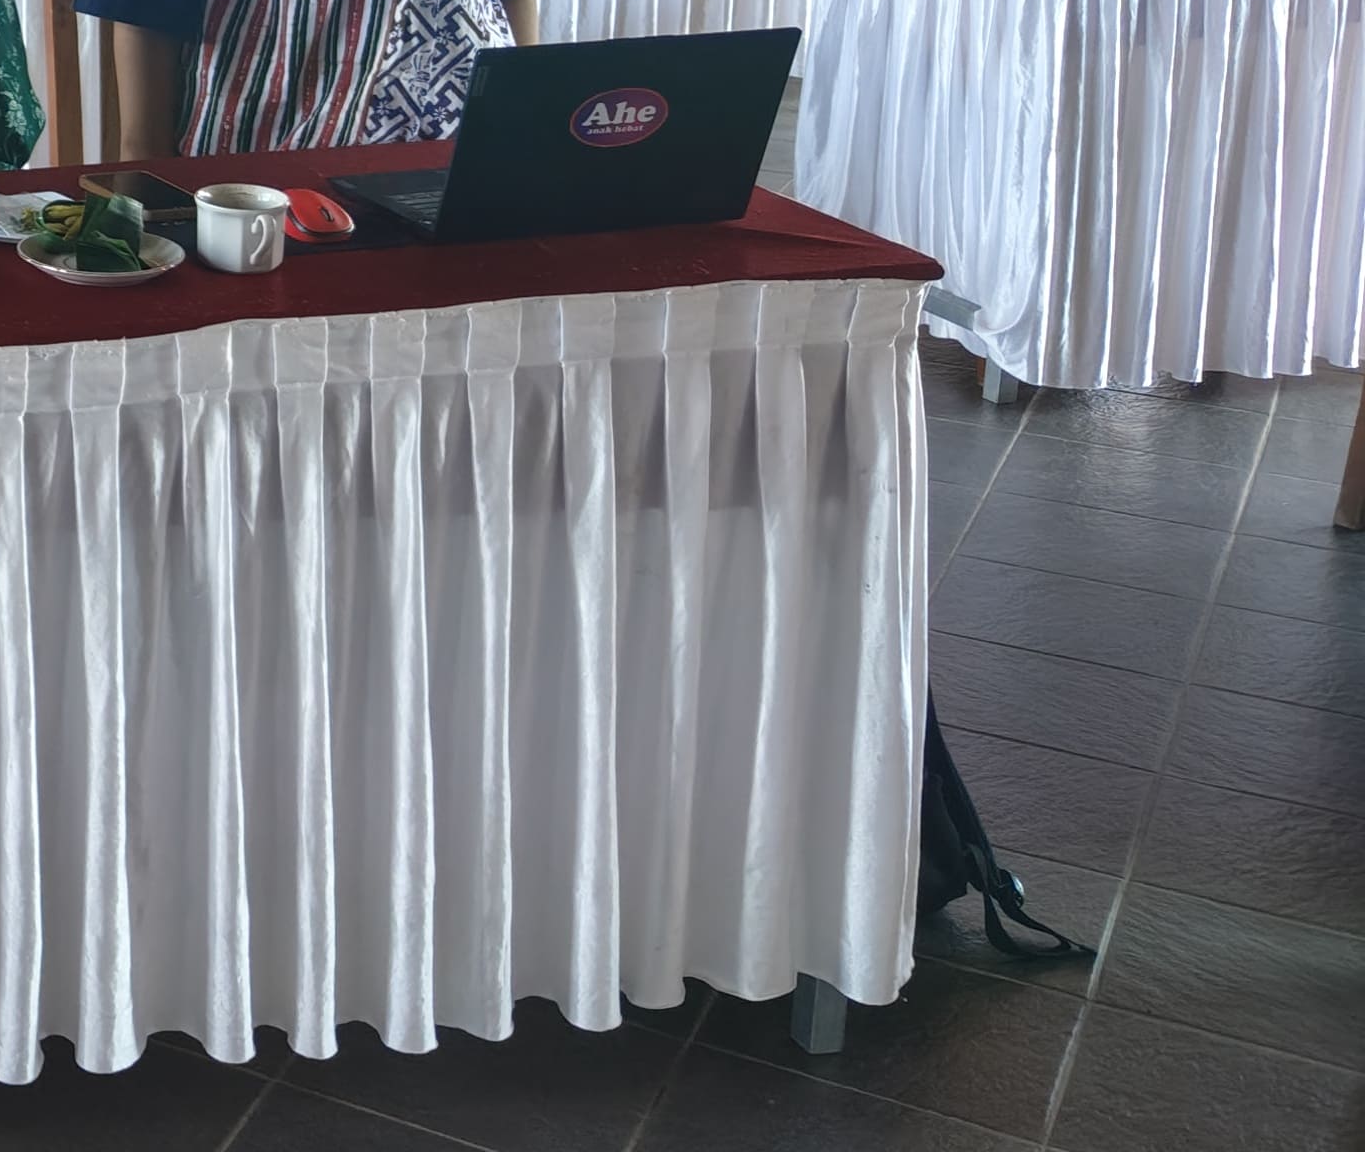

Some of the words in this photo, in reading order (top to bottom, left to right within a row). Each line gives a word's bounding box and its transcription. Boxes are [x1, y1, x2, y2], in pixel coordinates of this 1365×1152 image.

[581, 100, 657, 127] Ahe
[587, 126, 612, 135] anak
[614, 124, 645, 134] hebat
